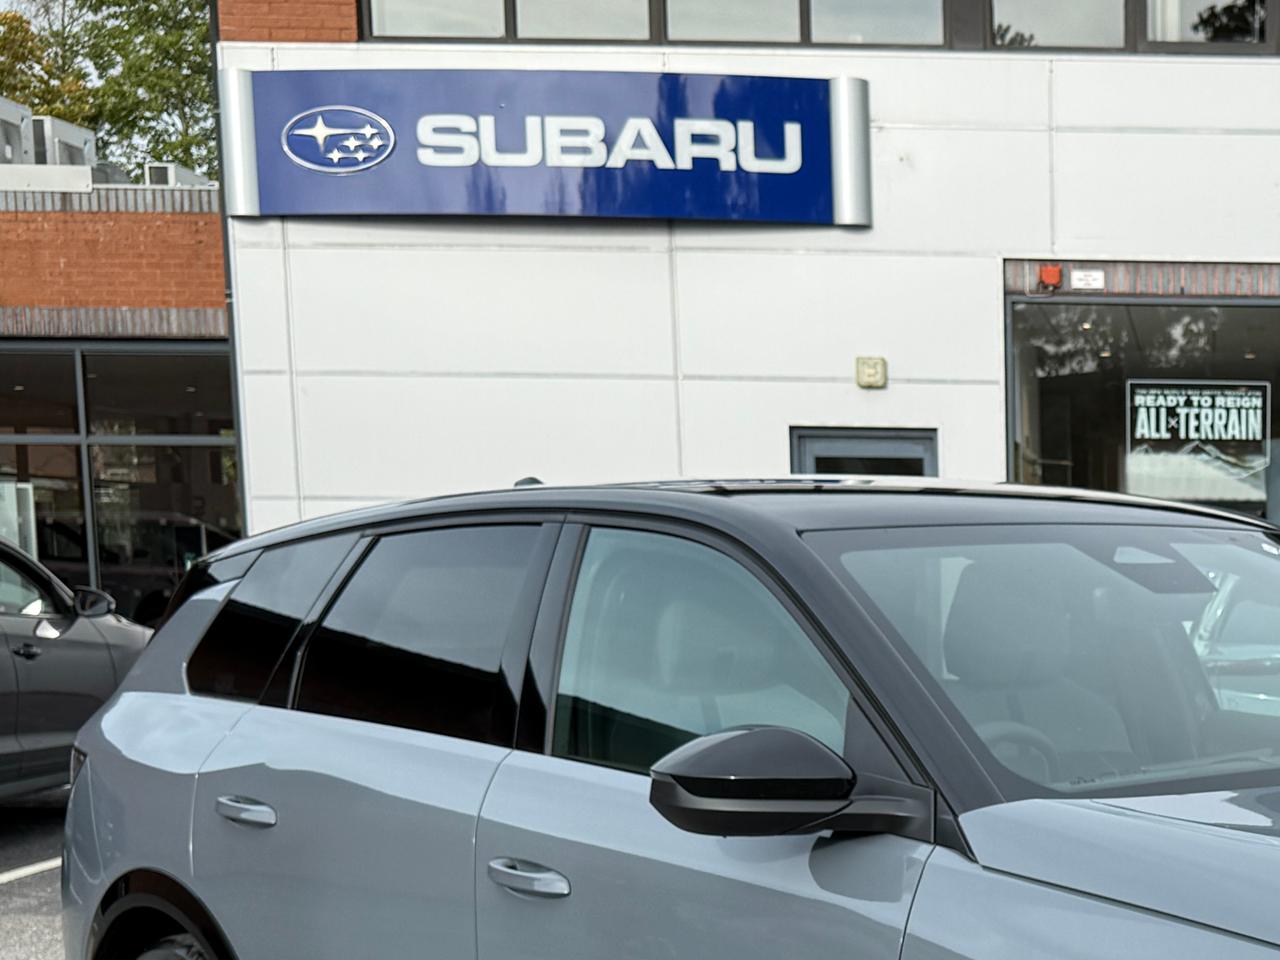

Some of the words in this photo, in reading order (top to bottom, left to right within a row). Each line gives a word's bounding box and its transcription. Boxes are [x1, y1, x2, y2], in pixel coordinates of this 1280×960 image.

[416, 113, 803, 174] SUBARU
[1134, 394, 1185, 407] READY
[1191, 395, 1213, 407] TO
[1214, 396, 1263, 409] REIGN
[1134, 407, 1172, 440] ALL
[1176, 409, 1263, 441] TERRAIN
